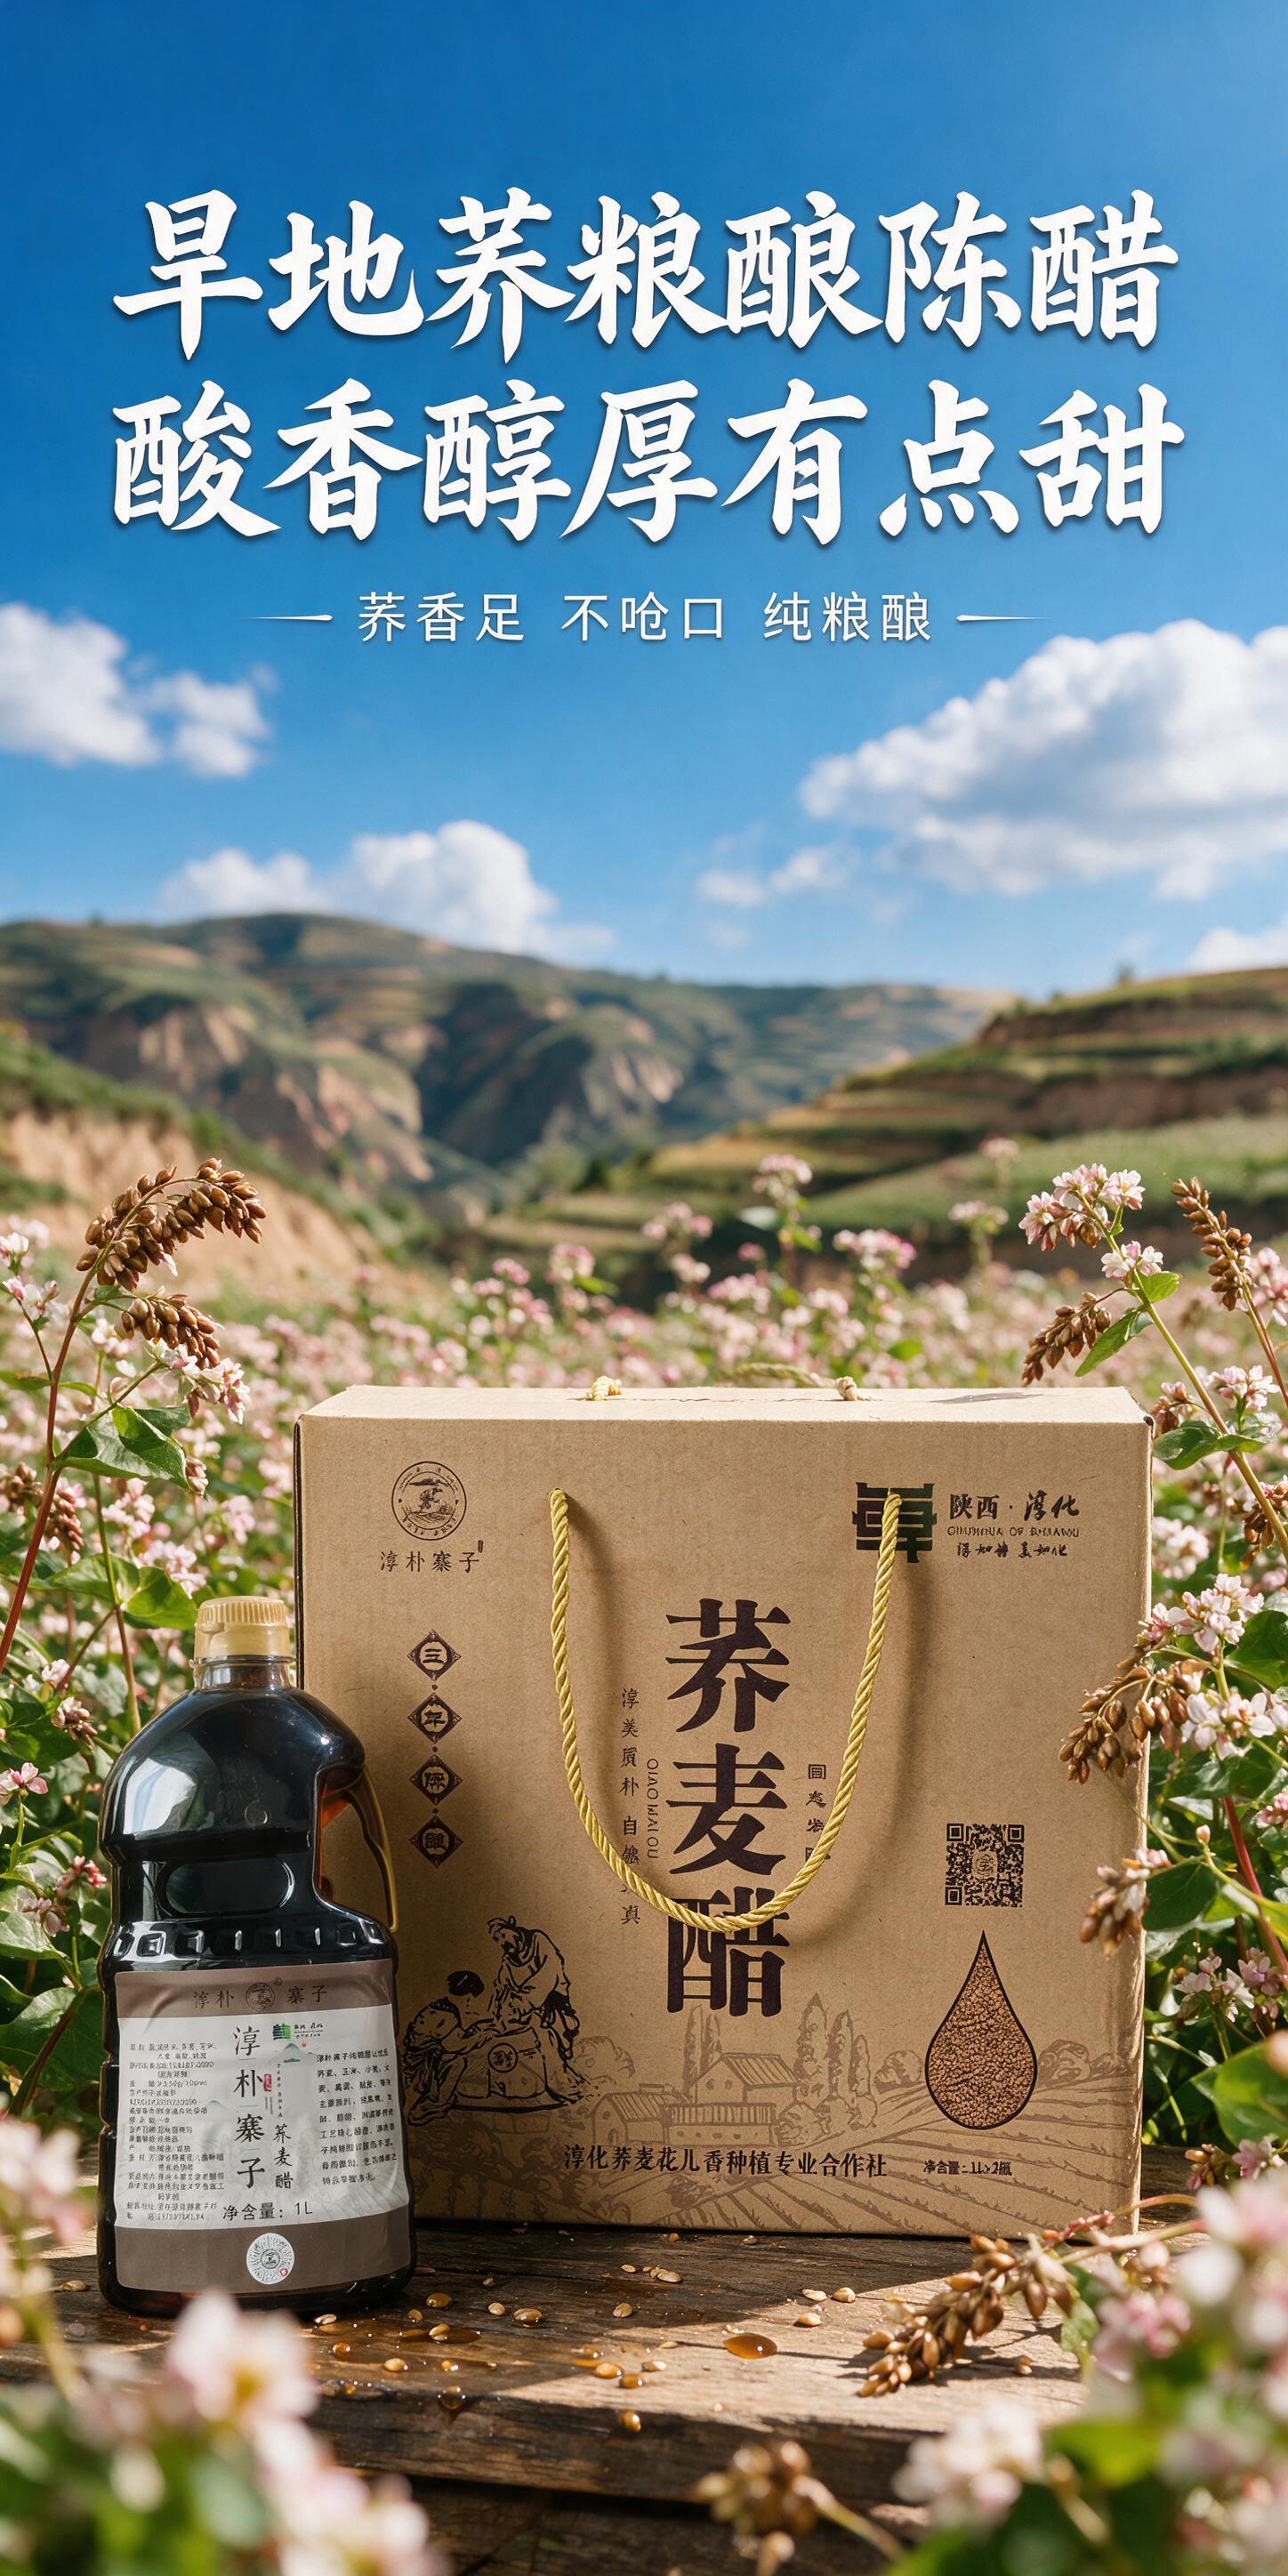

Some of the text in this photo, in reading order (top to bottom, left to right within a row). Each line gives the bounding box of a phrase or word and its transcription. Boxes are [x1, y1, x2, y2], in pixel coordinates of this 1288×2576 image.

[380, 1550, 479, 1574] 淳朴寨子
[665, 1598, 792, 2017] 荞麦醋
[232, 2025, 266, 2189] 淳朴寨子
[272, 2123, 294, 2189] 荞麦醋
[563, 2145, 888, 2178] 淳化荞麦花儿香种植专业合作社
